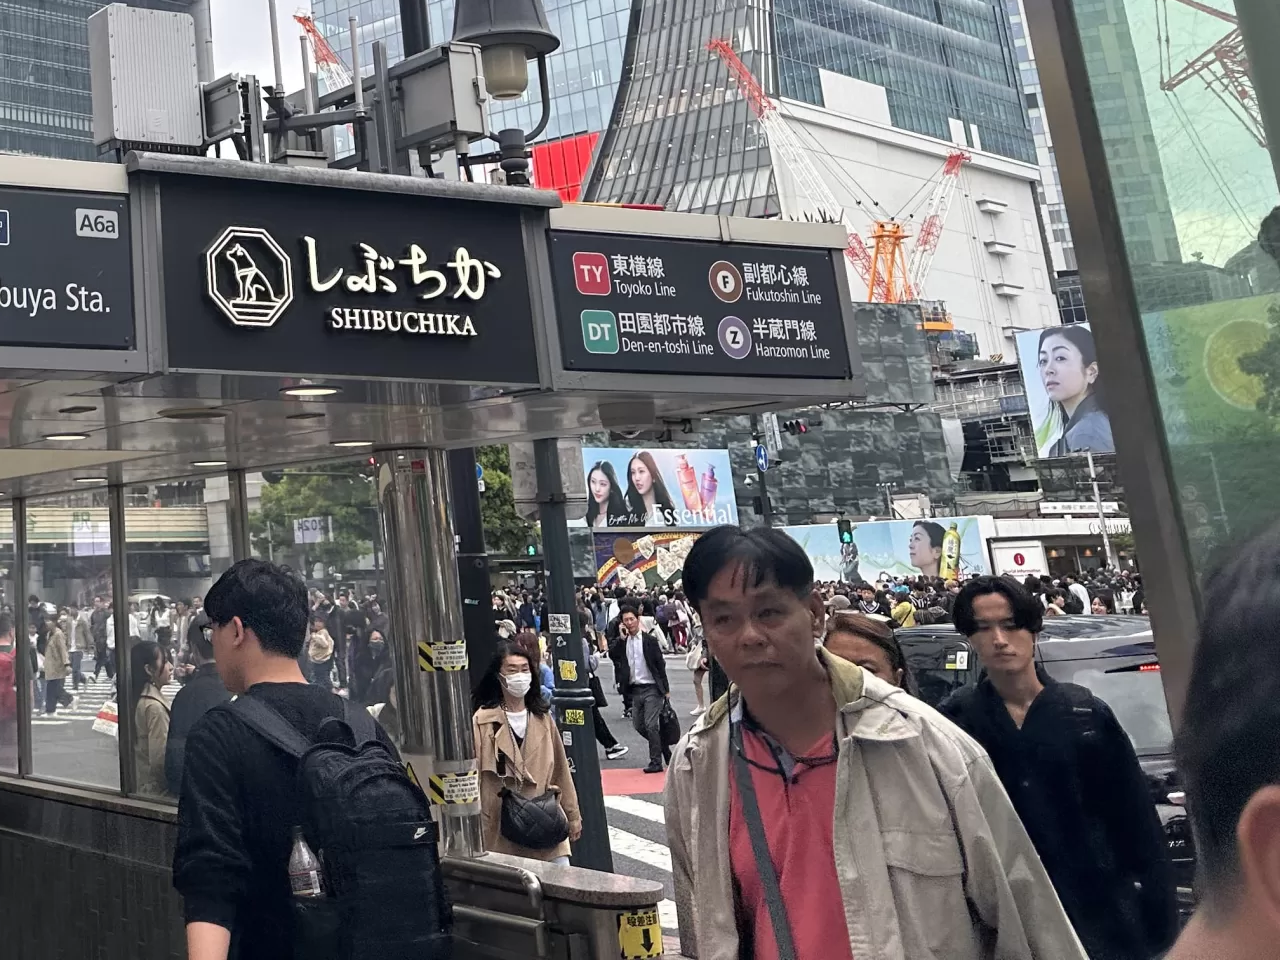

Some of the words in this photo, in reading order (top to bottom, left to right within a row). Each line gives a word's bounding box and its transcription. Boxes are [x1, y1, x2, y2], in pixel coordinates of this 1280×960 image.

[79, 214, 116, 234] A6a
[304, 235, 502, 300] しぶちか
[579, 263, 603, 283] TY
[610, 254, 665, 278] 東横線
[742, 261, 809, 287] 副都心線
[614, 279, 652, 297] Toyoko
[654, 281, 676, 297] Line
[721, 275, 731, 288] F
[65, 283, 111, 313] Sta.
[746, 288, 800, 303] Fukutoshin
[802, 290, 821, 305] Line
[331, 307, 477, 337] SHIBUCHIKA
[588, 322, 611, 340] DT
[618, 312, 706, 337] 田園都市線
[753, 317, 817, 341] 半蔵門線
[622, 340, 690, 354] Den-en-toshi
[693, 342, 714, 355] Line
[729, 331, 740, 344] Z
[755, 343, 810, 358] Hanzomon
[811, 345, 830, 359] Line
[651, 503, 733, 525] Essential
